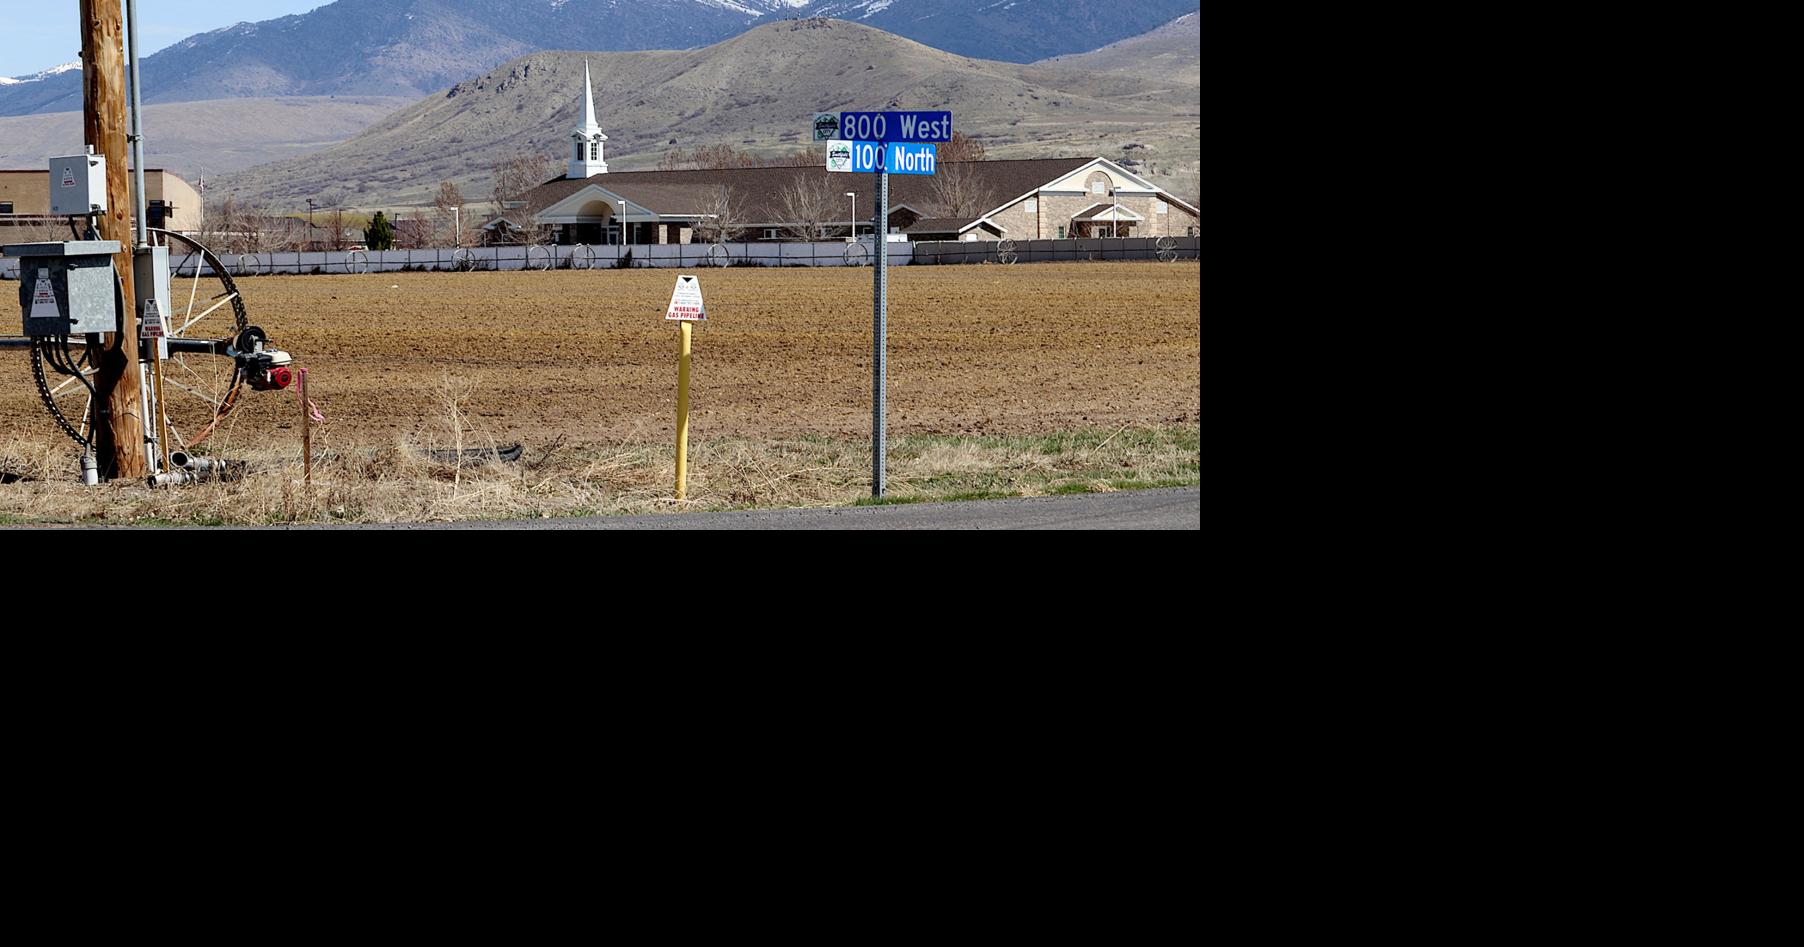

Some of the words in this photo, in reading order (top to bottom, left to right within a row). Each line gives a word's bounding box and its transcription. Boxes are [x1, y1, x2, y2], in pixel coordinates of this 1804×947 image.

[844, 114, 886, 140] 800
[900, 114, 949, 139] West
[855, 144, 885, 171] 100
[895, 146, 934, 172] North
